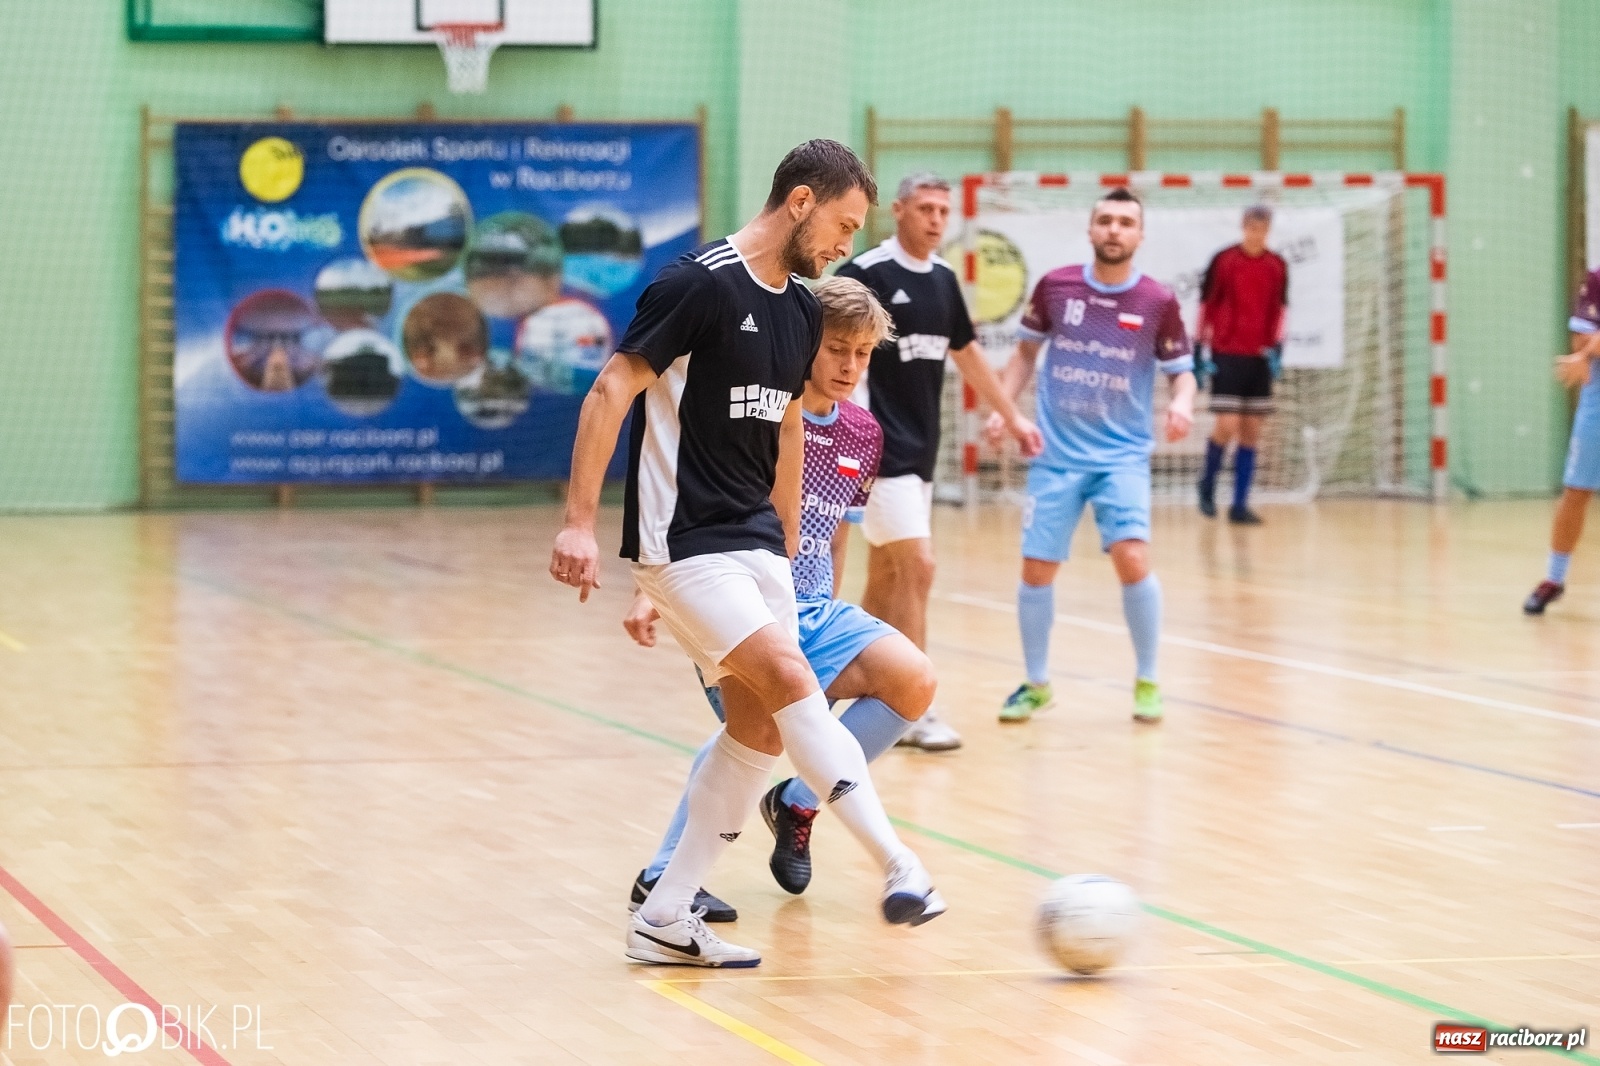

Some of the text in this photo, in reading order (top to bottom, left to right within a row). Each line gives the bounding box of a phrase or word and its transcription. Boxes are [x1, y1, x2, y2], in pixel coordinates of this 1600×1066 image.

[431, 136, 508, 163] Sportu
[524, 136, 631, 165] Rekreacji
[516, 165, 632, 191] Raciborzu
[1063, 298, 1086, 326] 18
[740, 325, 758, 333] adidas
